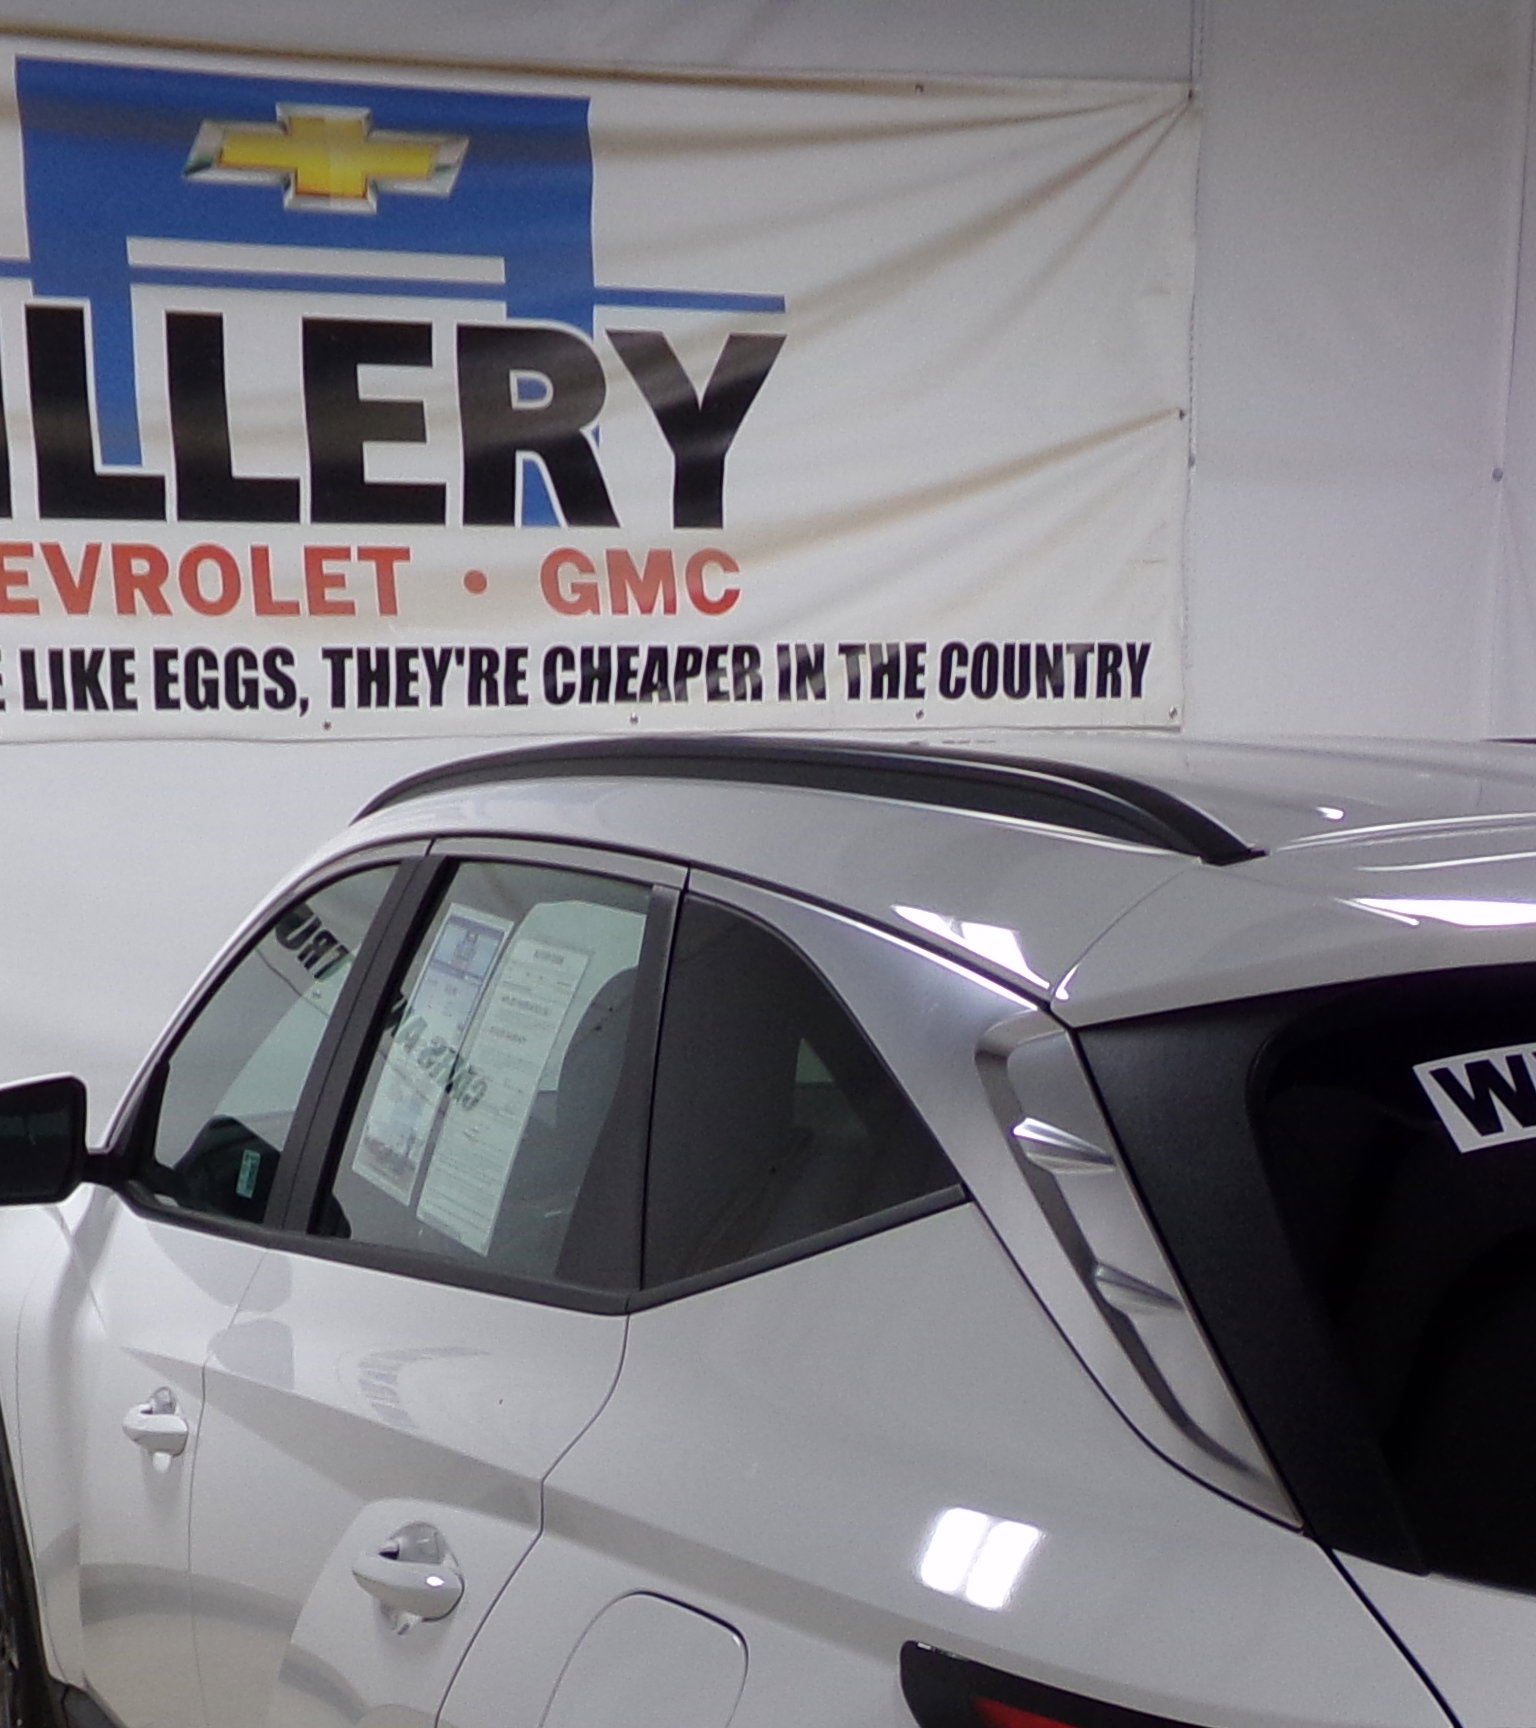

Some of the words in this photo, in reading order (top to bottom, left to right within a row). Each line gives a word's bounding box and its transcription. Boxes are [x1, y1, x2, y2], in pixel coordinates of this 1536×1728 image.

[537, 546, 742, 618] GMC
[19, 647, 139, 712] LIKE
[152, 646, 311, 717] EGGS,
[321, 646, 531, 711] THEY'RE
[541, 642, 764, 706] CHEAPER
[775, 642, 828, 702] IN
[838, 641, 928, 702] THE
[938, 641, 1153, 702] COUNTRY
